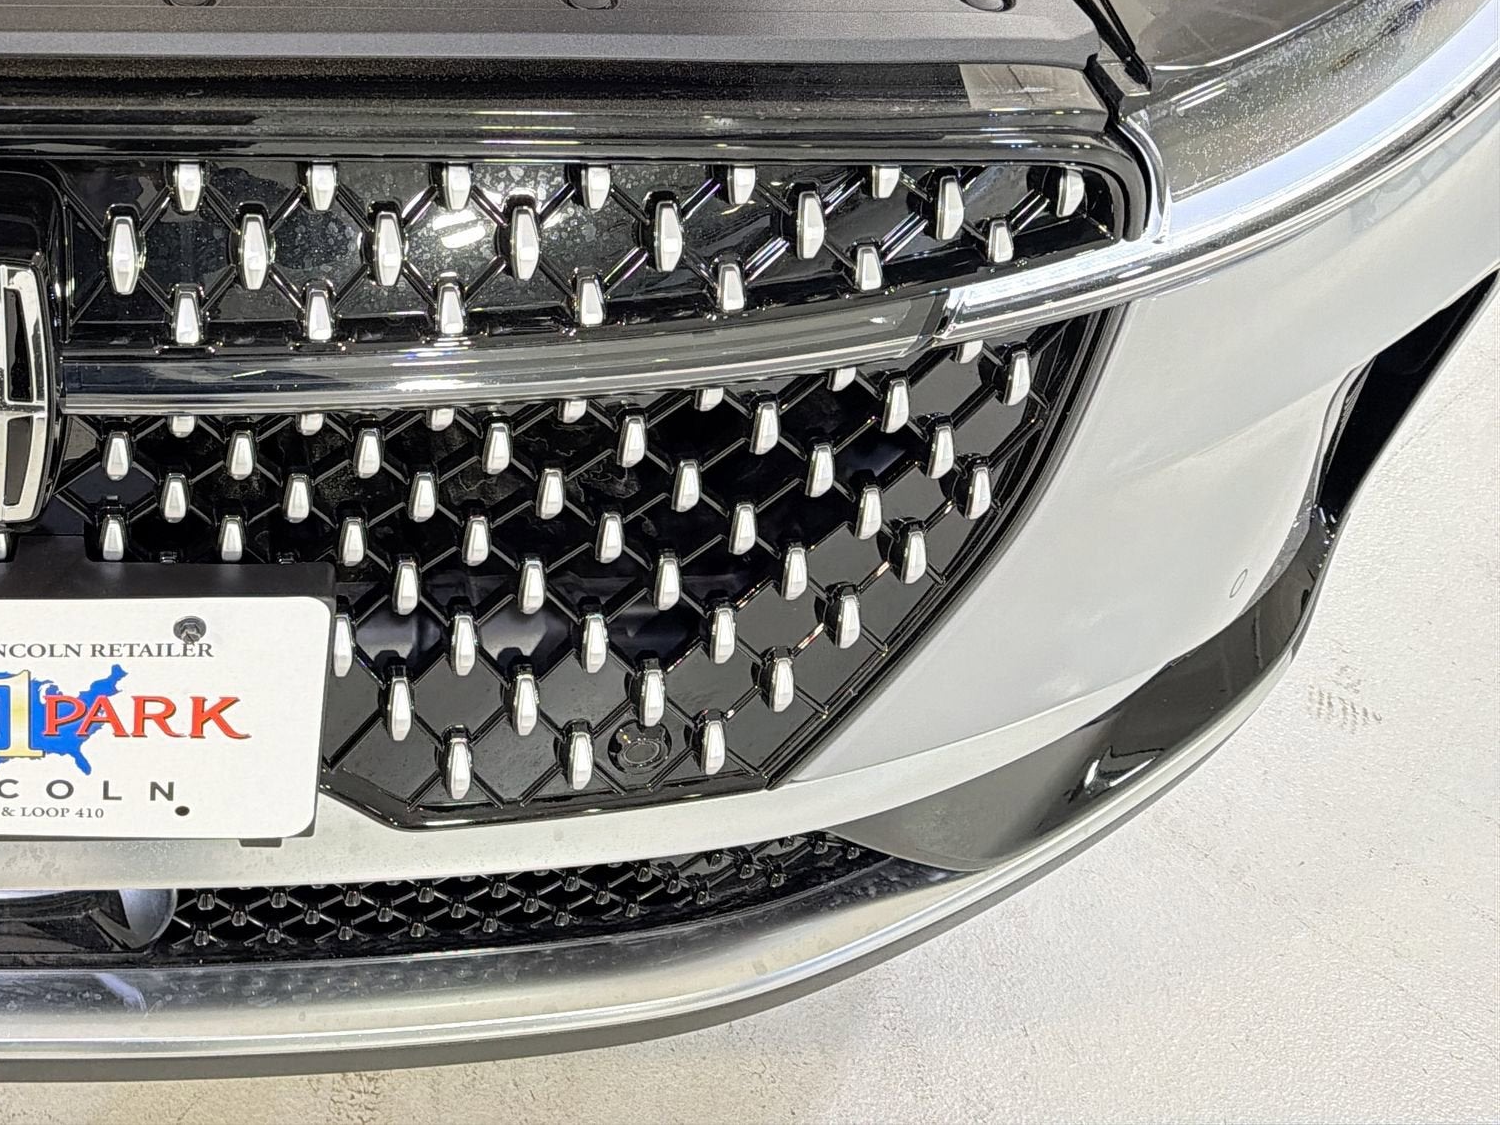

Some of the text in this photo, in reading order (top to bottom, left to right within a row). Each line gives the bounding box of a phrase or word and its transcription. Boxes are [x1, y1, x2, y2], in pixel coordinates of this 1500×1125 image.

[90, 642, 215, 659] RETAILER
[41, 694, 252, 740] PARK
[1, 806, 16, 817] &
[21, 806, 71, 818] LOOP
[75, 807, 105, 819] 410
